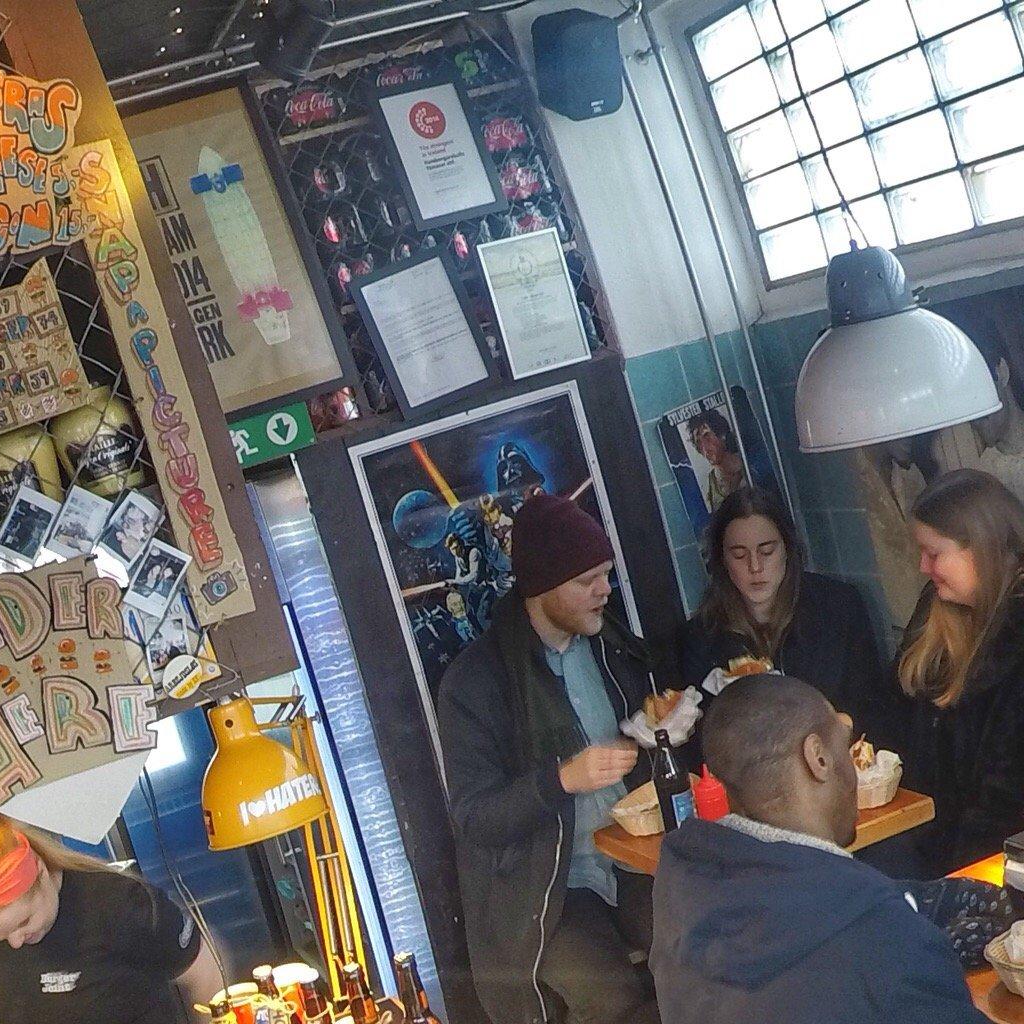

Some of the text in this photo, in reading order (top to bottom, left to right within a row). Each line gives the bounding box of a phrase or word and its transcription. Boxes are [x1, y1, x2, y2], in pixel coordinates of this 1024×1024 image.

[77, 151, 139, 307] SNAP
[127, 300, 149, 328] A
[130, 327, 223, 571] PICTURE
